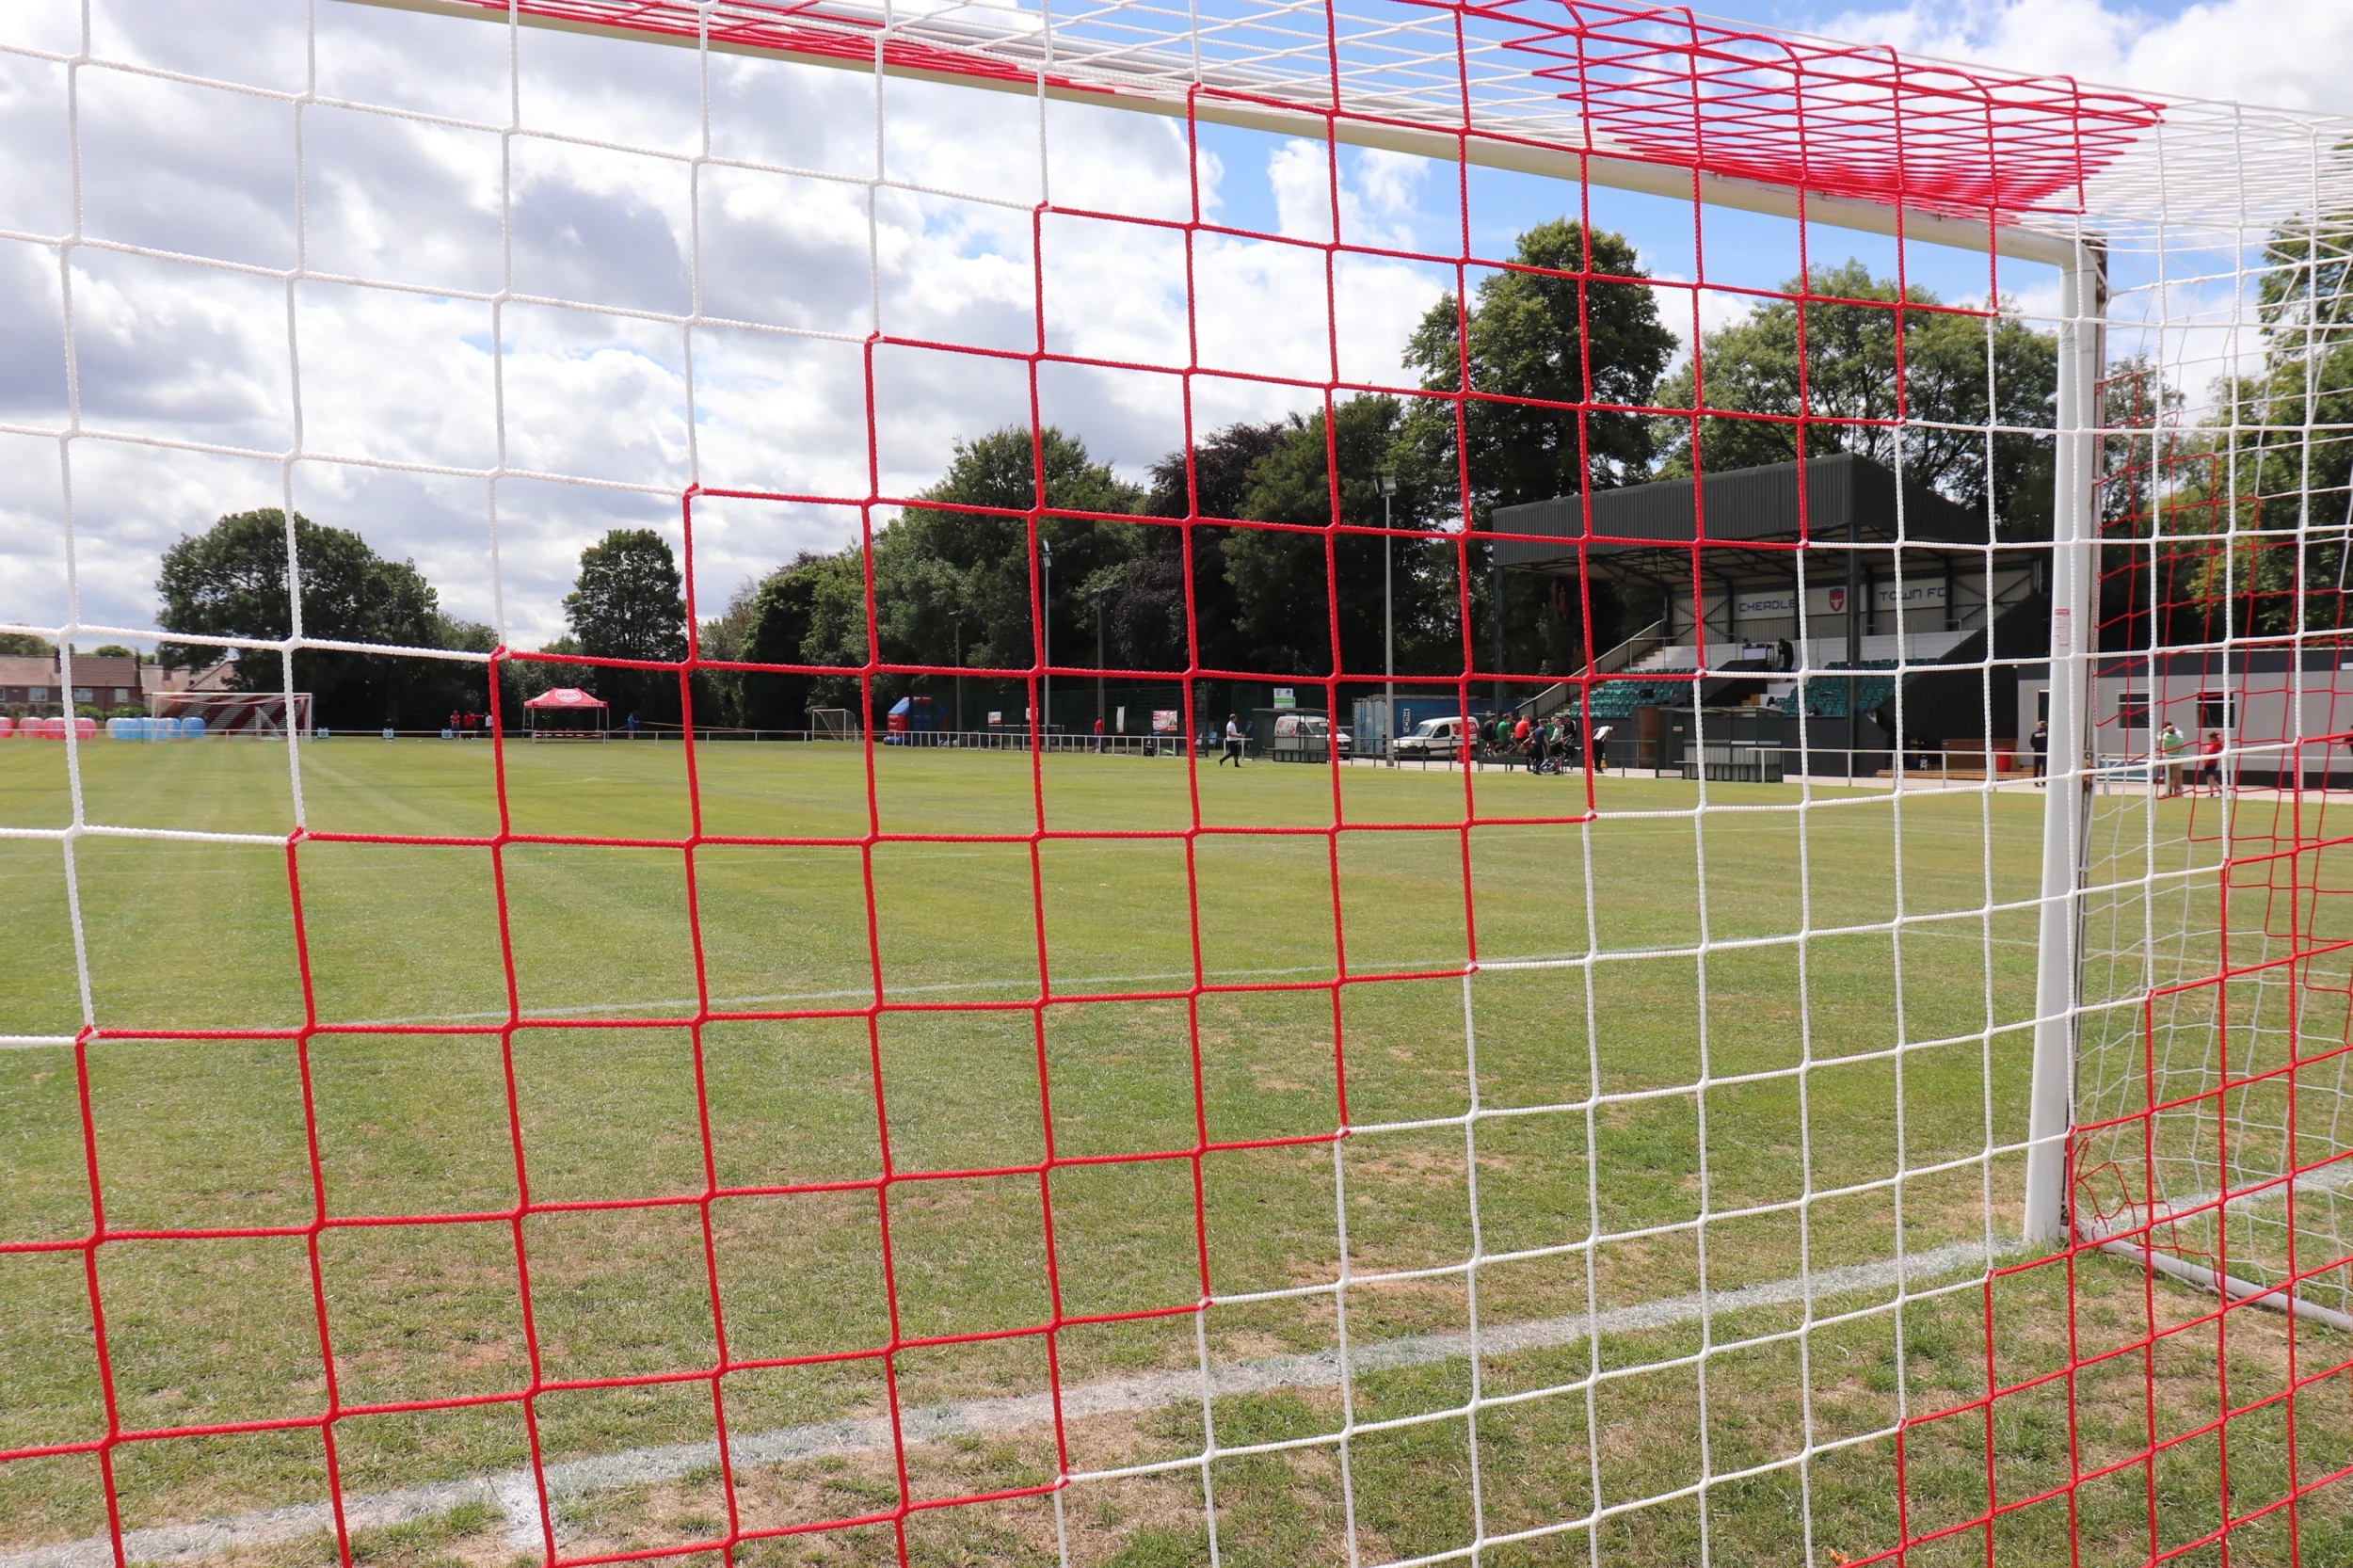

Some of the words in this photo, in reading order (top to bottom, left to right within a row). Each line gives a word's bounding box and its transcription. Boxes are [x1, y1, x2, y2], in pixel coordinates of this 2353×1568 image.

[1738, 599, 1795, 613] CHEADLE
[1879, 588, 1922, 601] TOWN
[1928, 586, 1946, 599] FC
